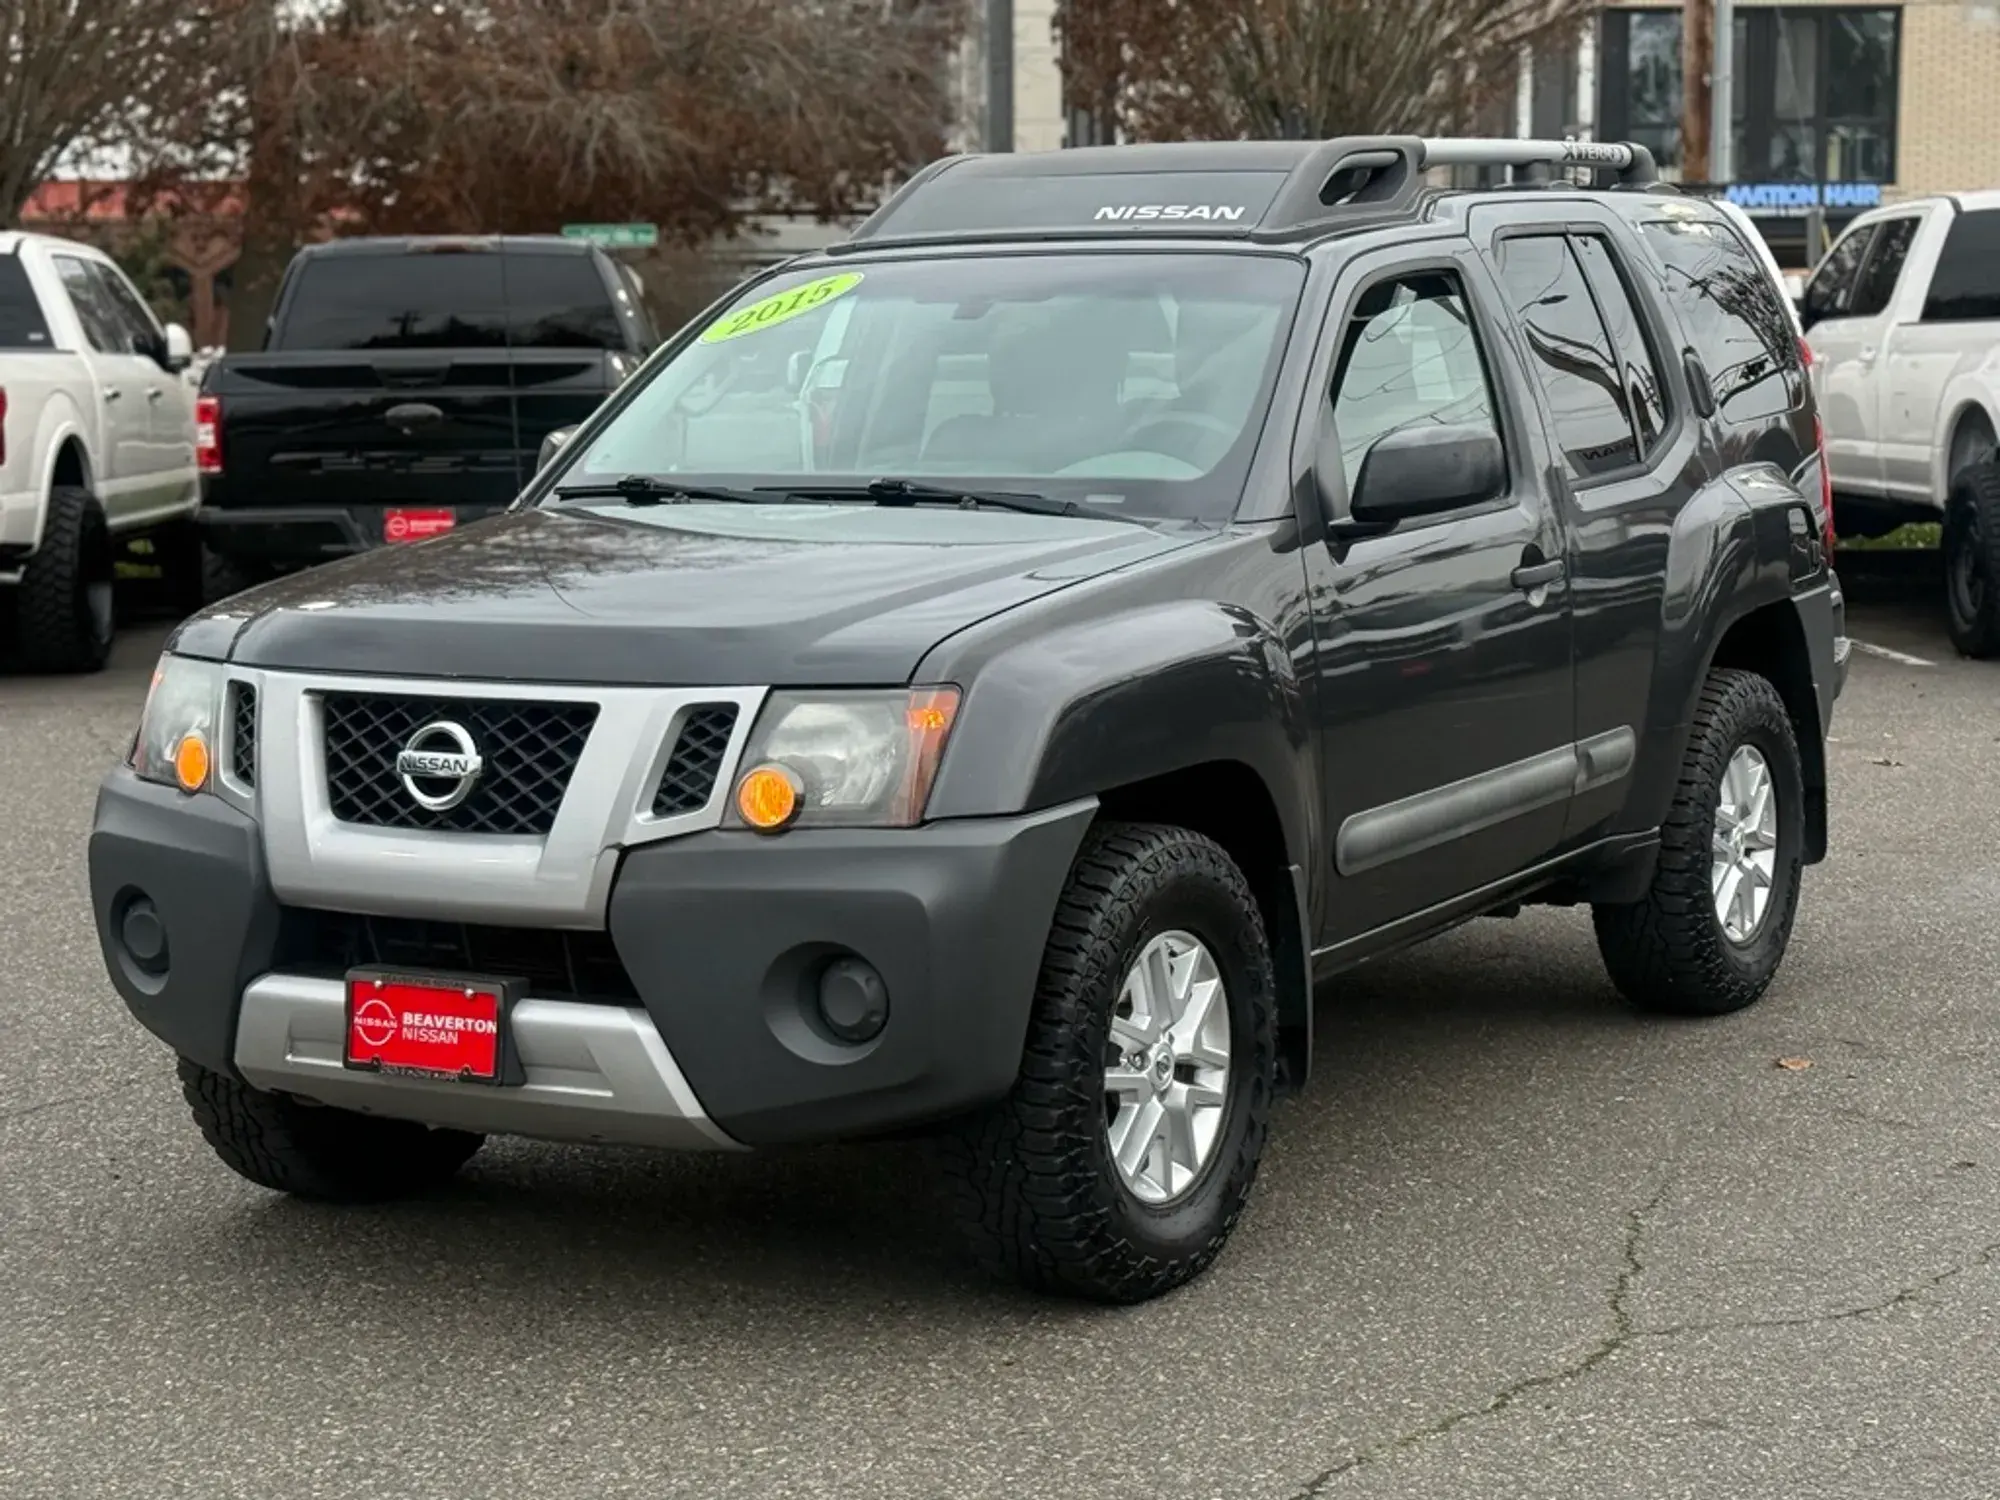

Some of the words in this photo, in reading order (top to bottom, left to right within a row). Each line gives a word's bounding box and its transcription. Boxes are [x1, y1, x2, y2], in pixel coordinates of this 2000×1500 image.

[1823, 184, 1880, 207] HAIR
[1094, 205, 1245, 220] NISSAN
[726, 279, 838, 335] 2015
[400, 755, 468, 773] NISSAN
[354, 1016, 398, 1029] NISSAN
[402, 1011, 497, 1034] BEAVERTON
[402, 1027, 459, 1045] NISSAN
